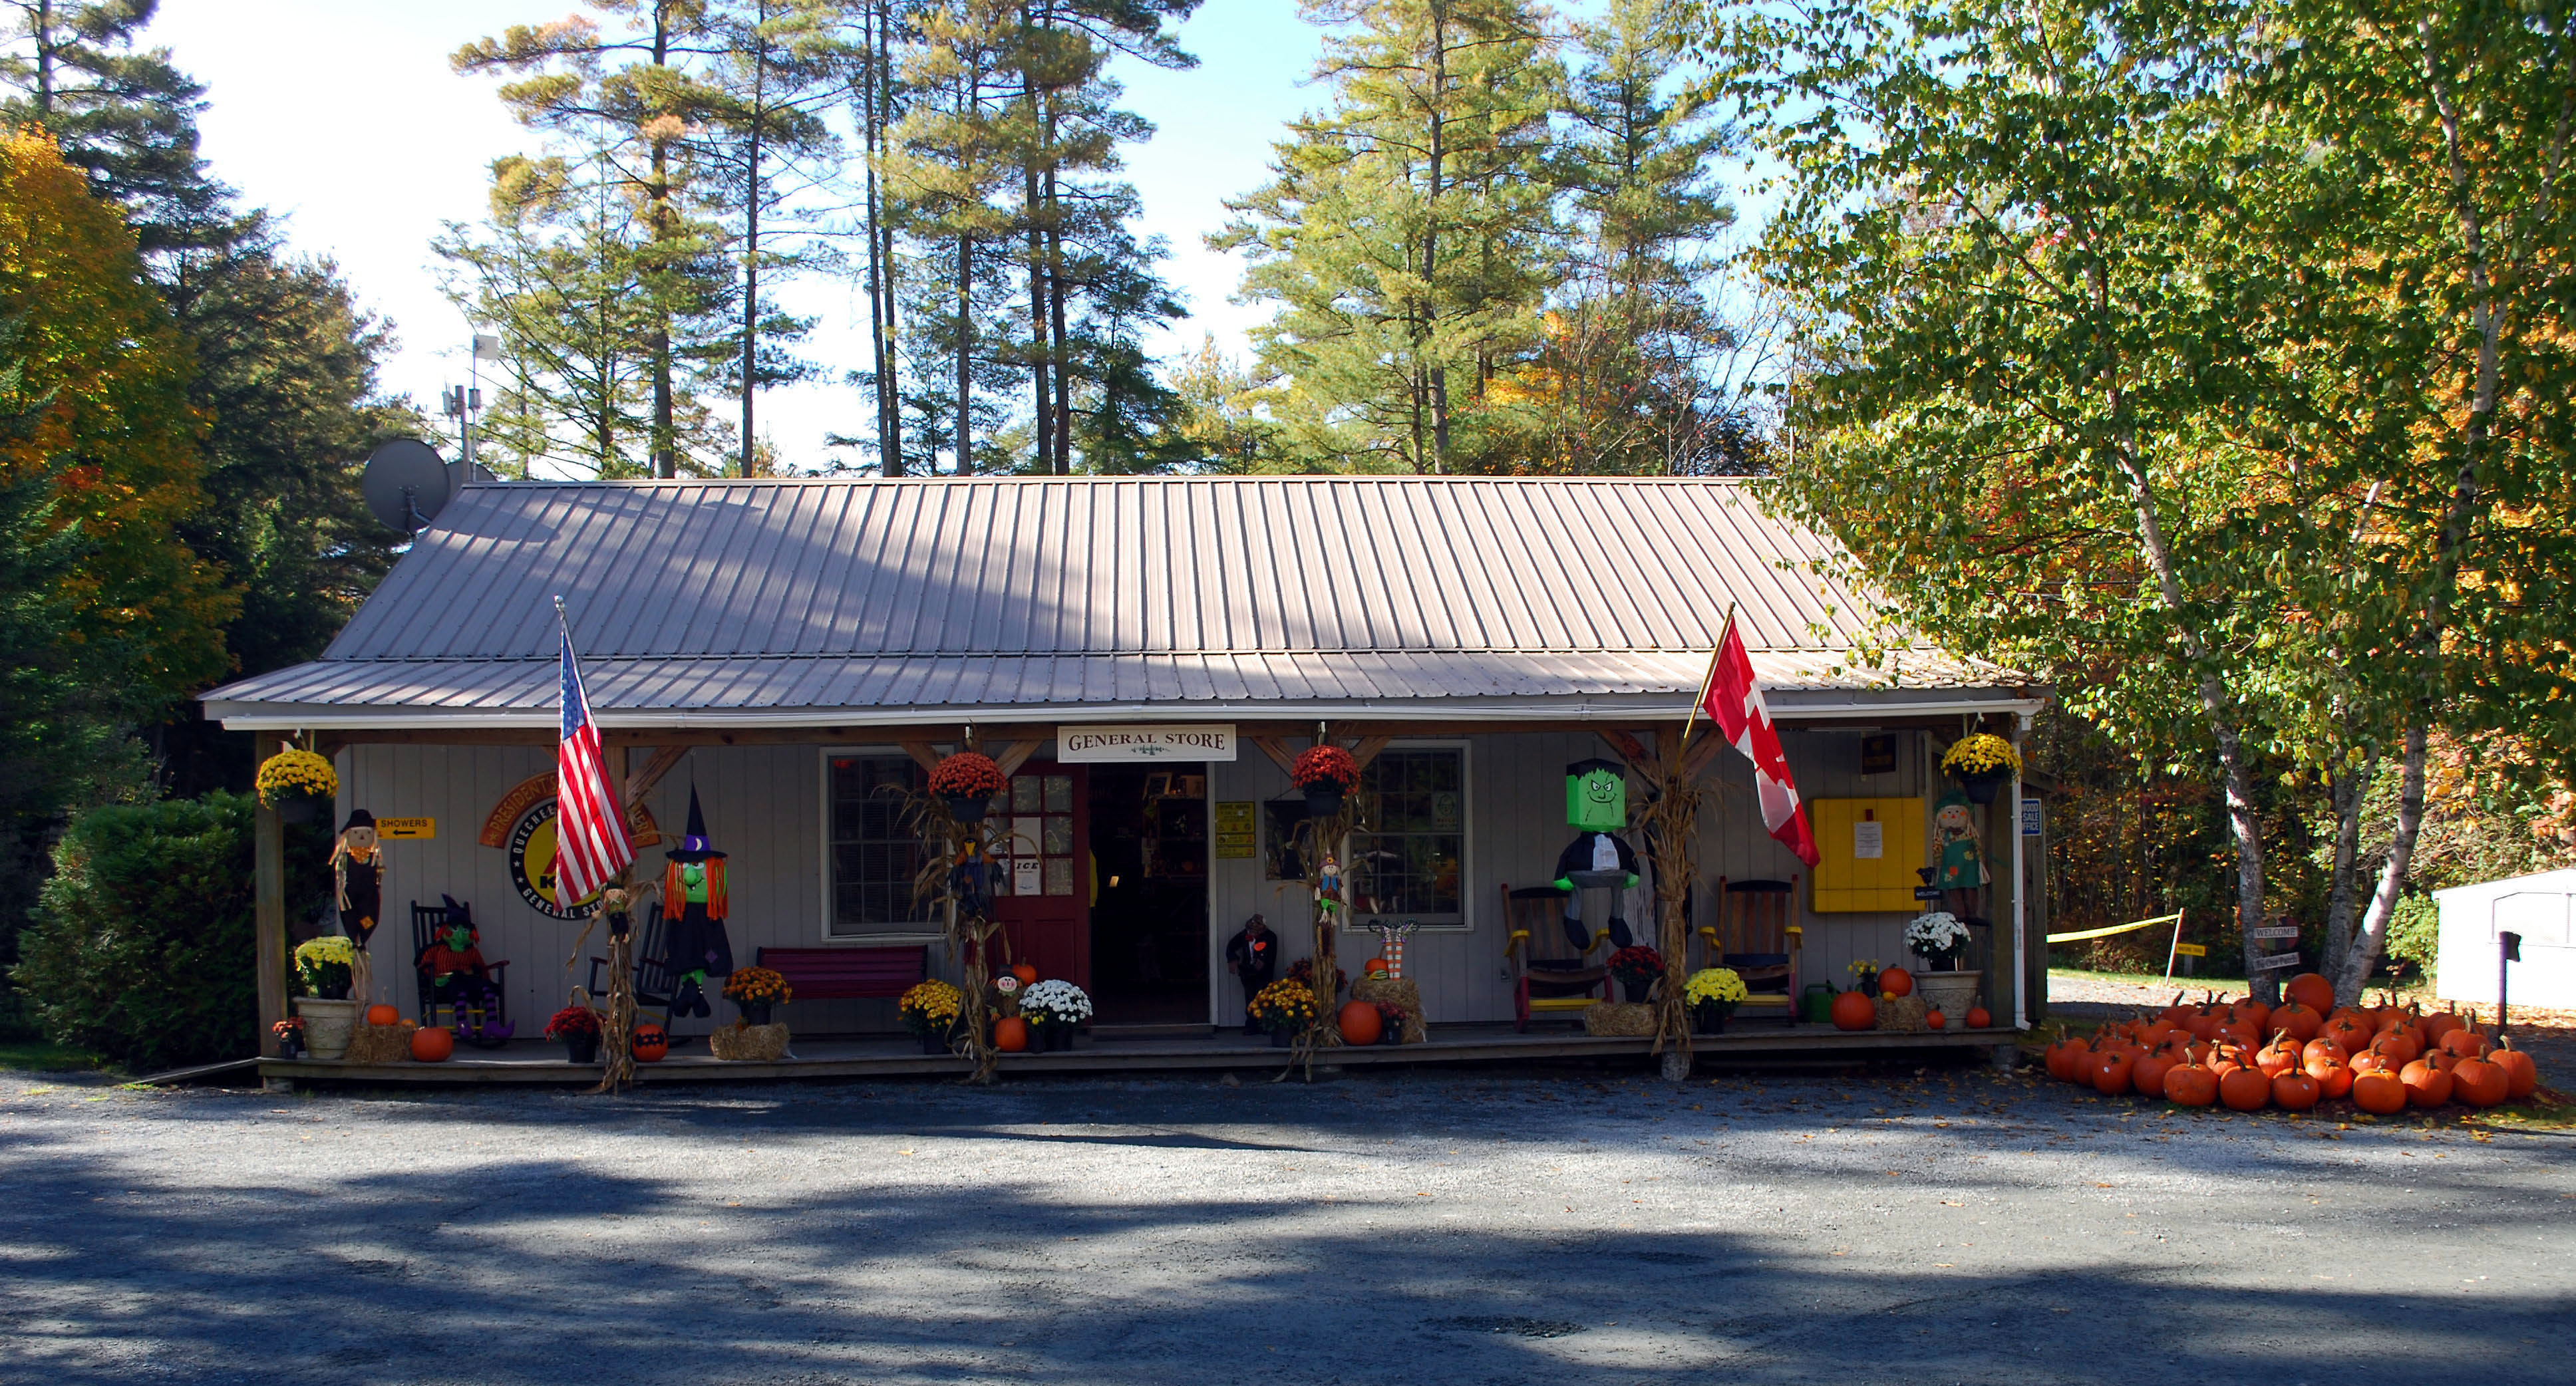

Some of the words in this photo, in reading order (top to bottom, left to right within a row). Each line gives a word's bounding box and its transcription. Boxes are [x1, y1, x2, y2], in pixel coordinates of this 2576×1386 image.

[1068, 734, 1156, 751] GENERAL
[1166, 734, 1225, 750] STORE
[490, 775, 558, 833] PRESIDENT'S
[381, 819, 427, 827] SHOWERS
[2257, 927, 2296, 936] WELCOME
